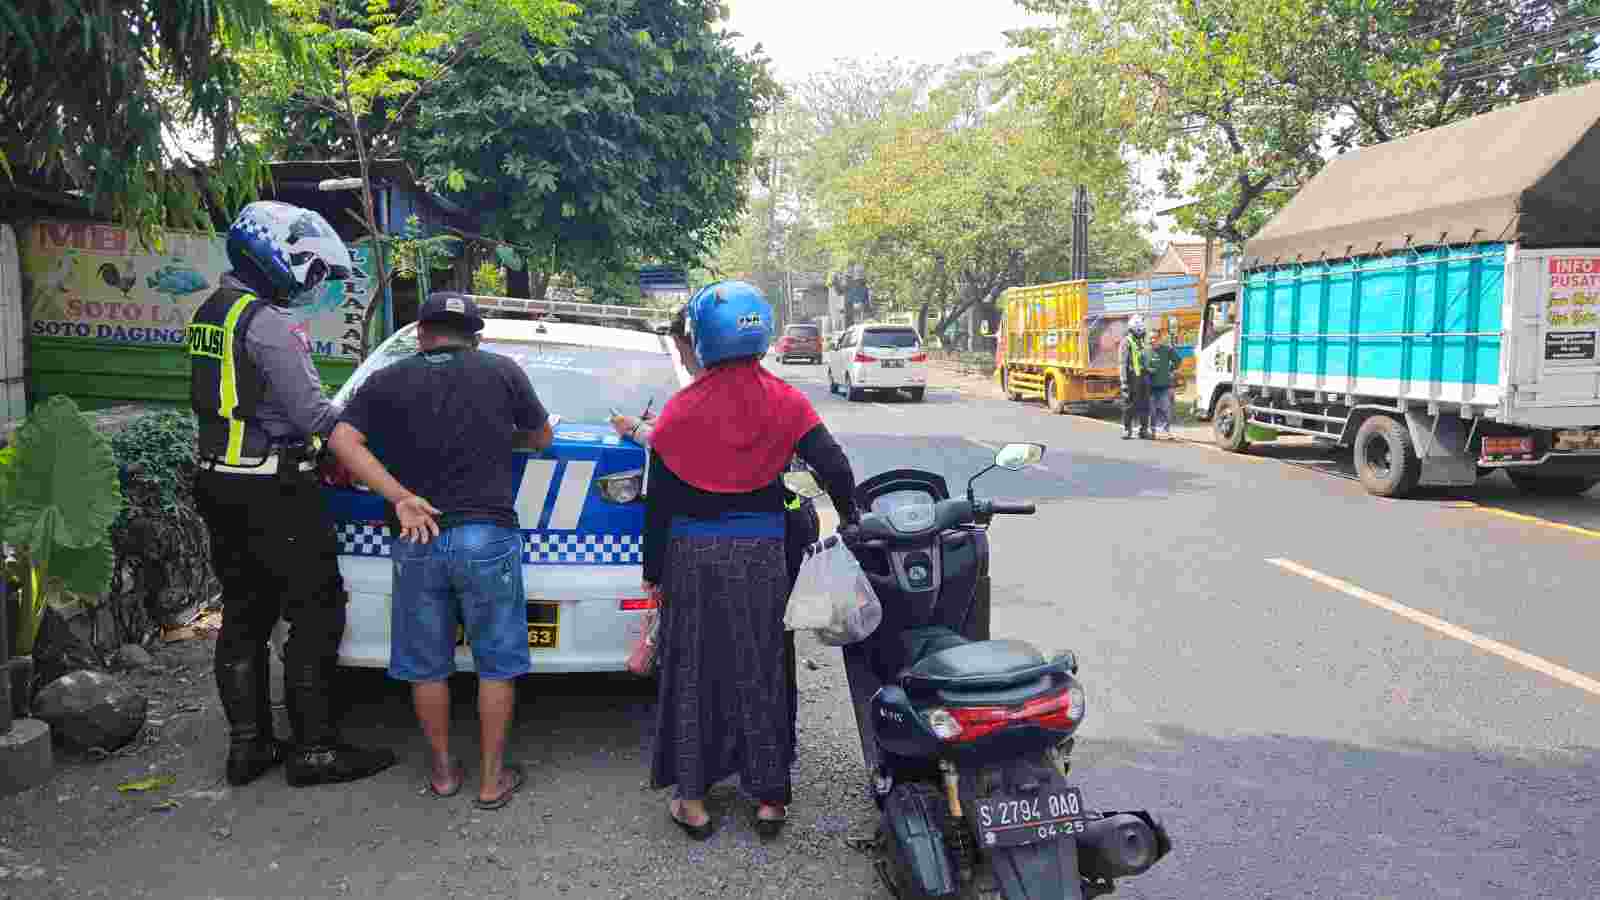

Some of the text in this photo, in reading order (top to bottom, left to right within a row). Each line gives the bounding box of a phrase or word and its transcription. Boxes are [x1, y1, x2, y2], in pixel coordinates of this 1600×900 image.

[1555, 260, 1593, 273] INFO
[64, 299, 192, 322] SOTO LA
[33, 319, 91, 337] SOTO
[95, 324, 184, 344] DAGING
[186, 327, 224, 356] POLISI
[980, 805, 993, 826] S
[999, 798, 1040, 825] 2794
